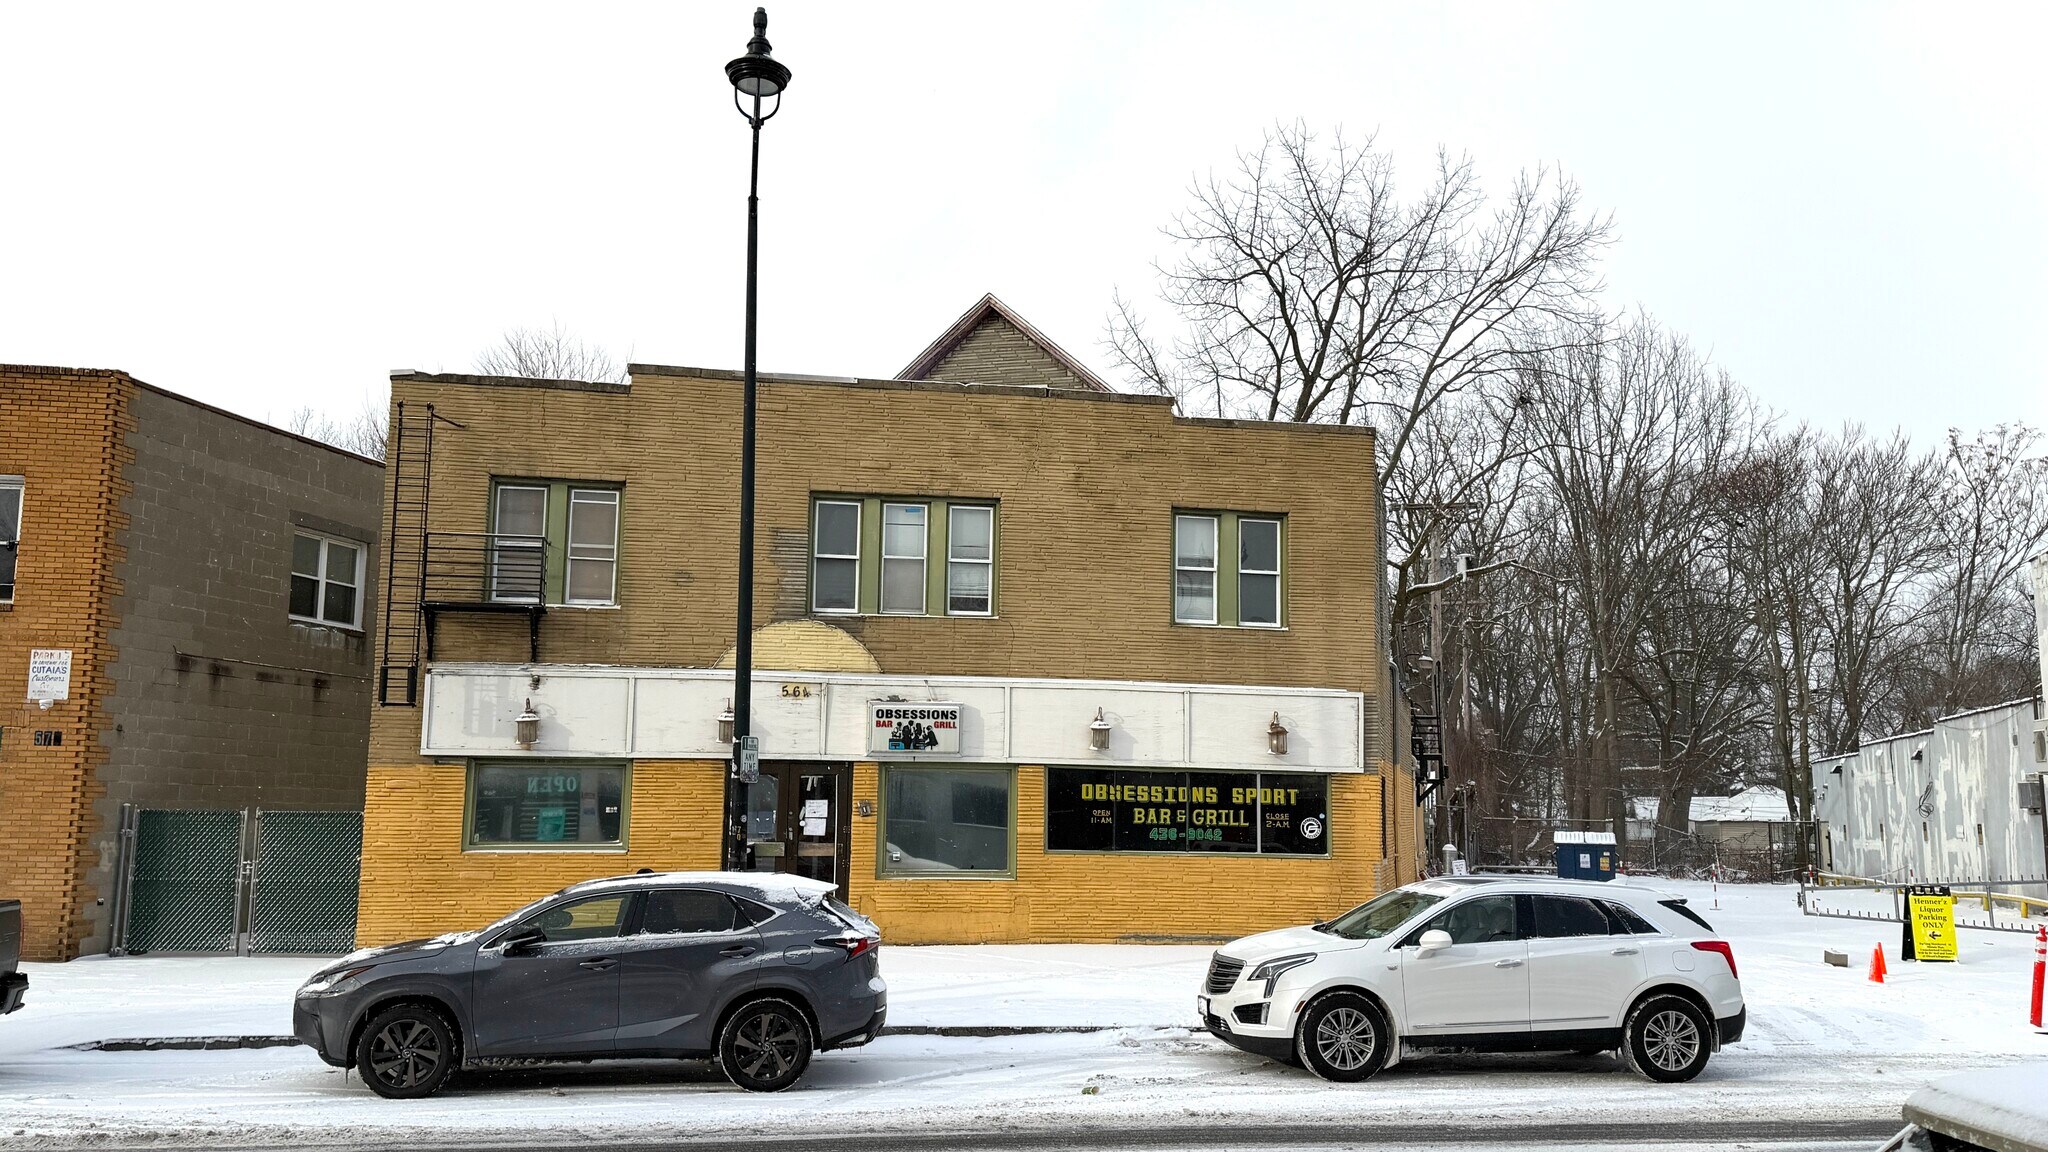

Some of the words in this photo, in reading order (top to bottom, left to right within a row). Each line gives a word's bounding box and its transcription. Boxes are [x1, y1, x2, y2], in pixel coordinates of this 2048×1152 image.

[876, 709, 957, 720] OBSESSIONS
[875, 720, 893, 728] BAR
[933, 721, 957, 729] GRILL
[745, 752, 755, 761] ANY
[744, 762, 756, 771] TIME
[1232, 787, 1300, 805] SPORT
[1133, 808, 1171, 825] BAR
[1176, 809, 1187, 822] &
[1192, 809, 1250, 827] GRILL
[1265, 812, 1290, 820] CLOSE
[1919, 906, 1944, 914] Liquor
[1918, 914, 1947, 922] Parking
